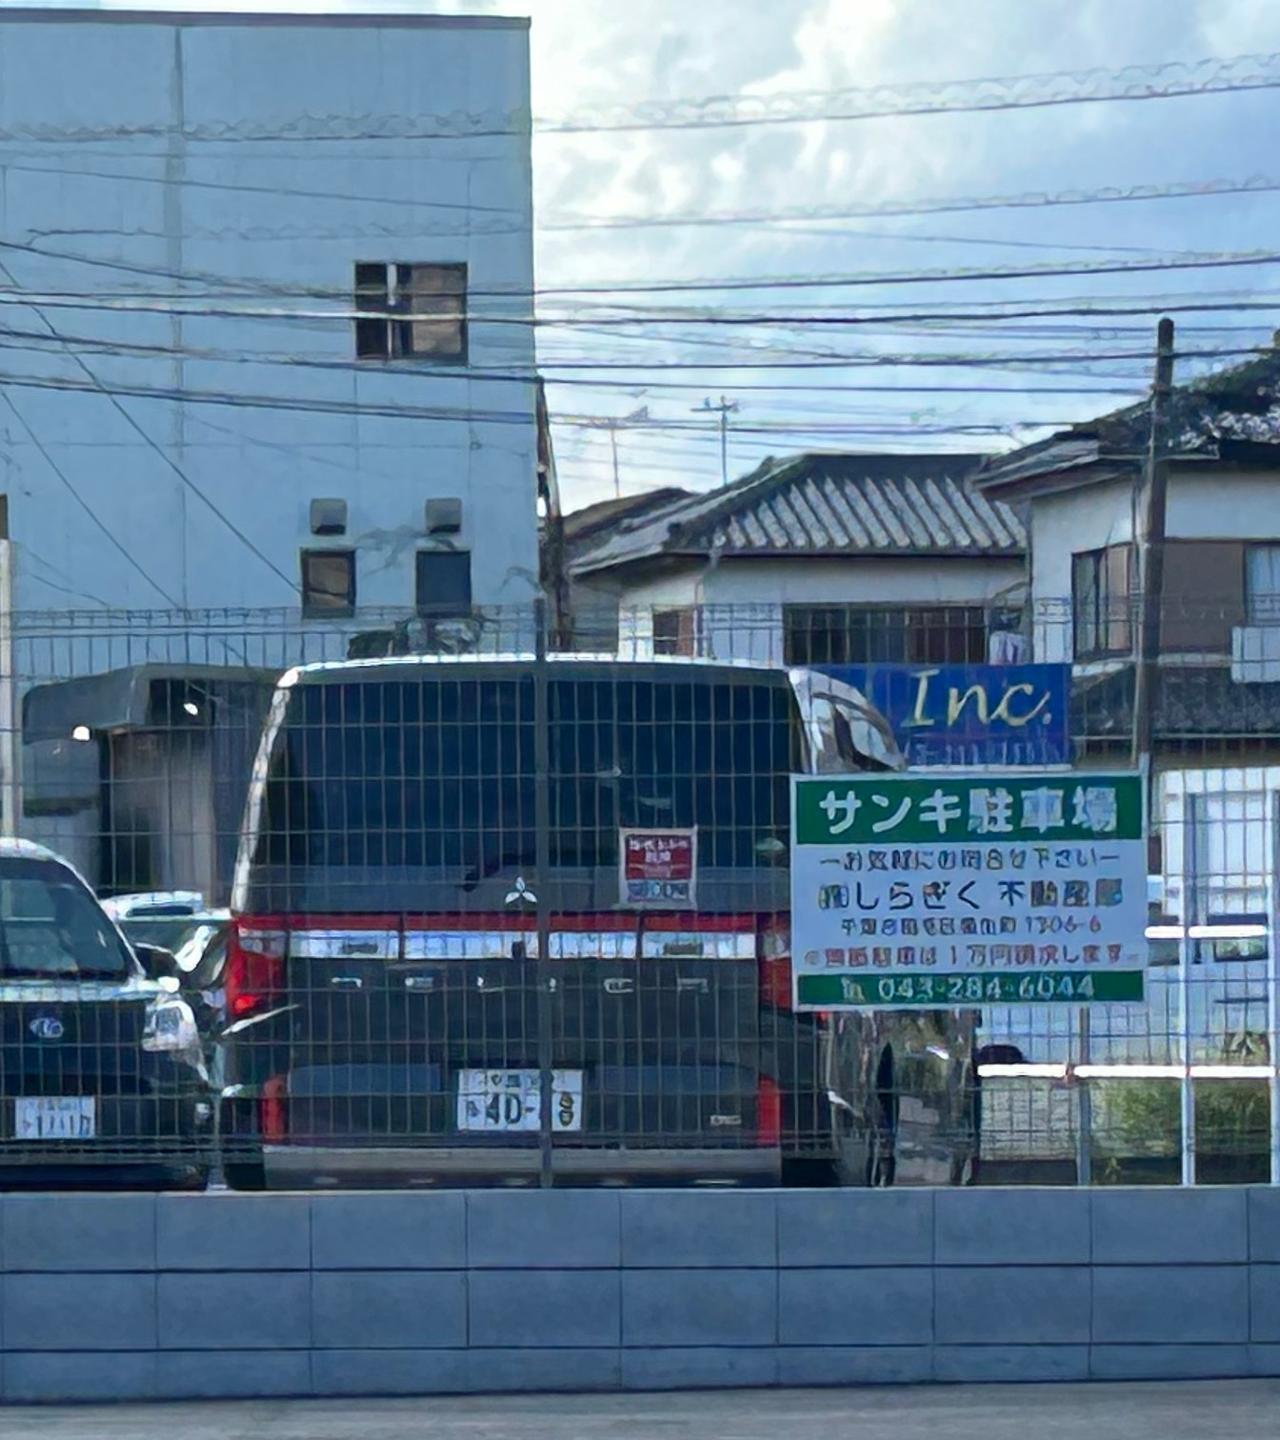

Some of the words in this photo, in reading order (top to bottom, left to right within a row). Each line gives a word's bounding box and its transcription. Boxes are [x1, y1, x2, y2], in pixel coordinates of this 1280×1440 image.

[819, 785, 1118, 834] サンキ駐車場
